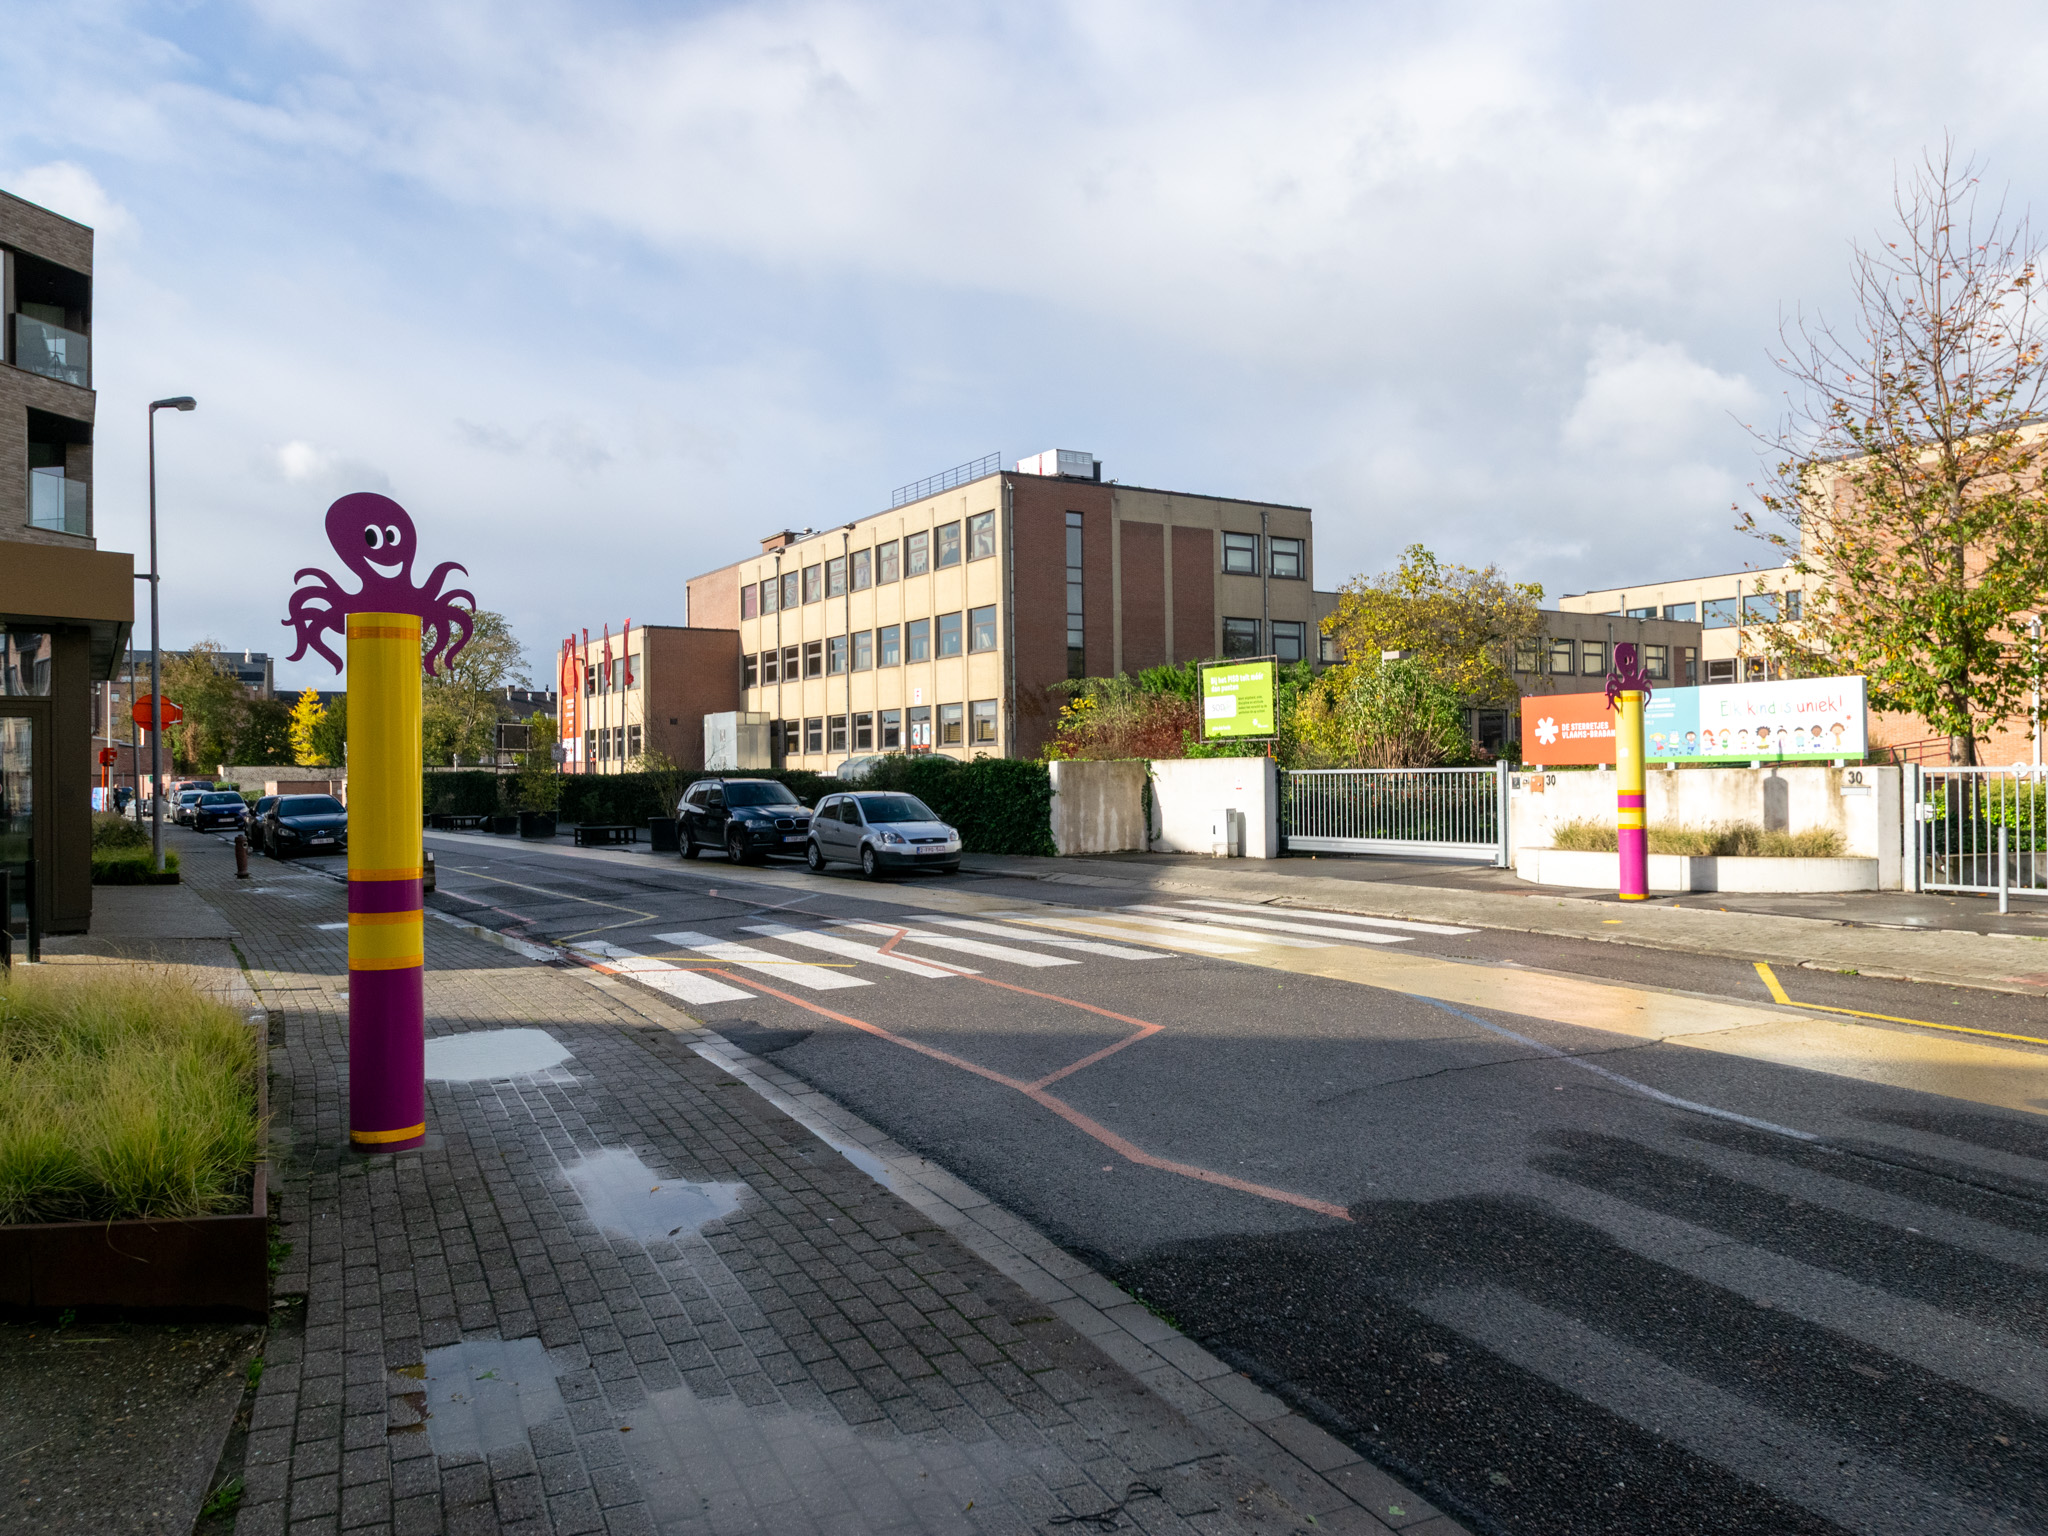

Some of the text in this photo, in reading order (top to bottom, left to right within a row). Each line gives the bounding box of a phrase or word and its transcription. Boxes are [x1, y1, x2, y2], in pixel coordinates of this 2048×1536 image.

[1747, 699, 1776, 716] kind
[1780, 702, 1792, 714] is
[1797, 694, 1843, 714] uniek!
[1562, 722, 1608, 731] DE STERRETJES
[1562, 729, 1616, 739] VLAAMS-BRABAN
[1546, 774, 1556, 786] 30
[1848, 771, 1862, 785] 30
